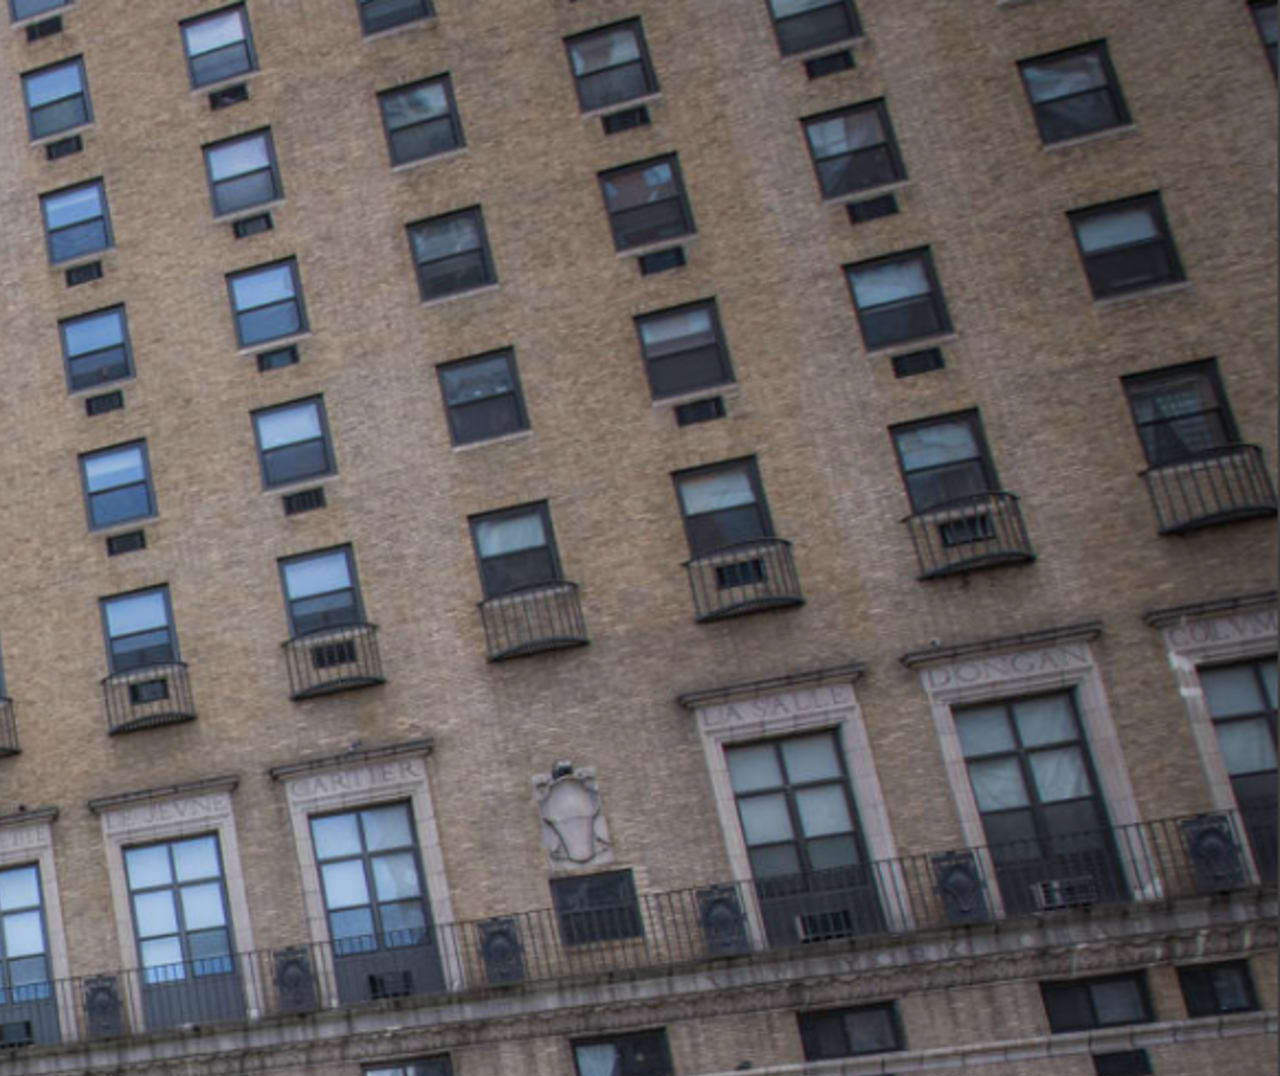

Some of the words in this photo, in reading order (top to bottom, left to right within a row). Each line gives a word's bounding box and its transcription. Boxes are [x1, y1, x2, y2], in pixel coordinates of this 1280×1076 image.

[927, 645, 1093, 688] DONGAN
[703, 705, 743, 727] LA
[753, 685, 849, 717] SALLE
[291, 760, 423, 798] CARTIER
